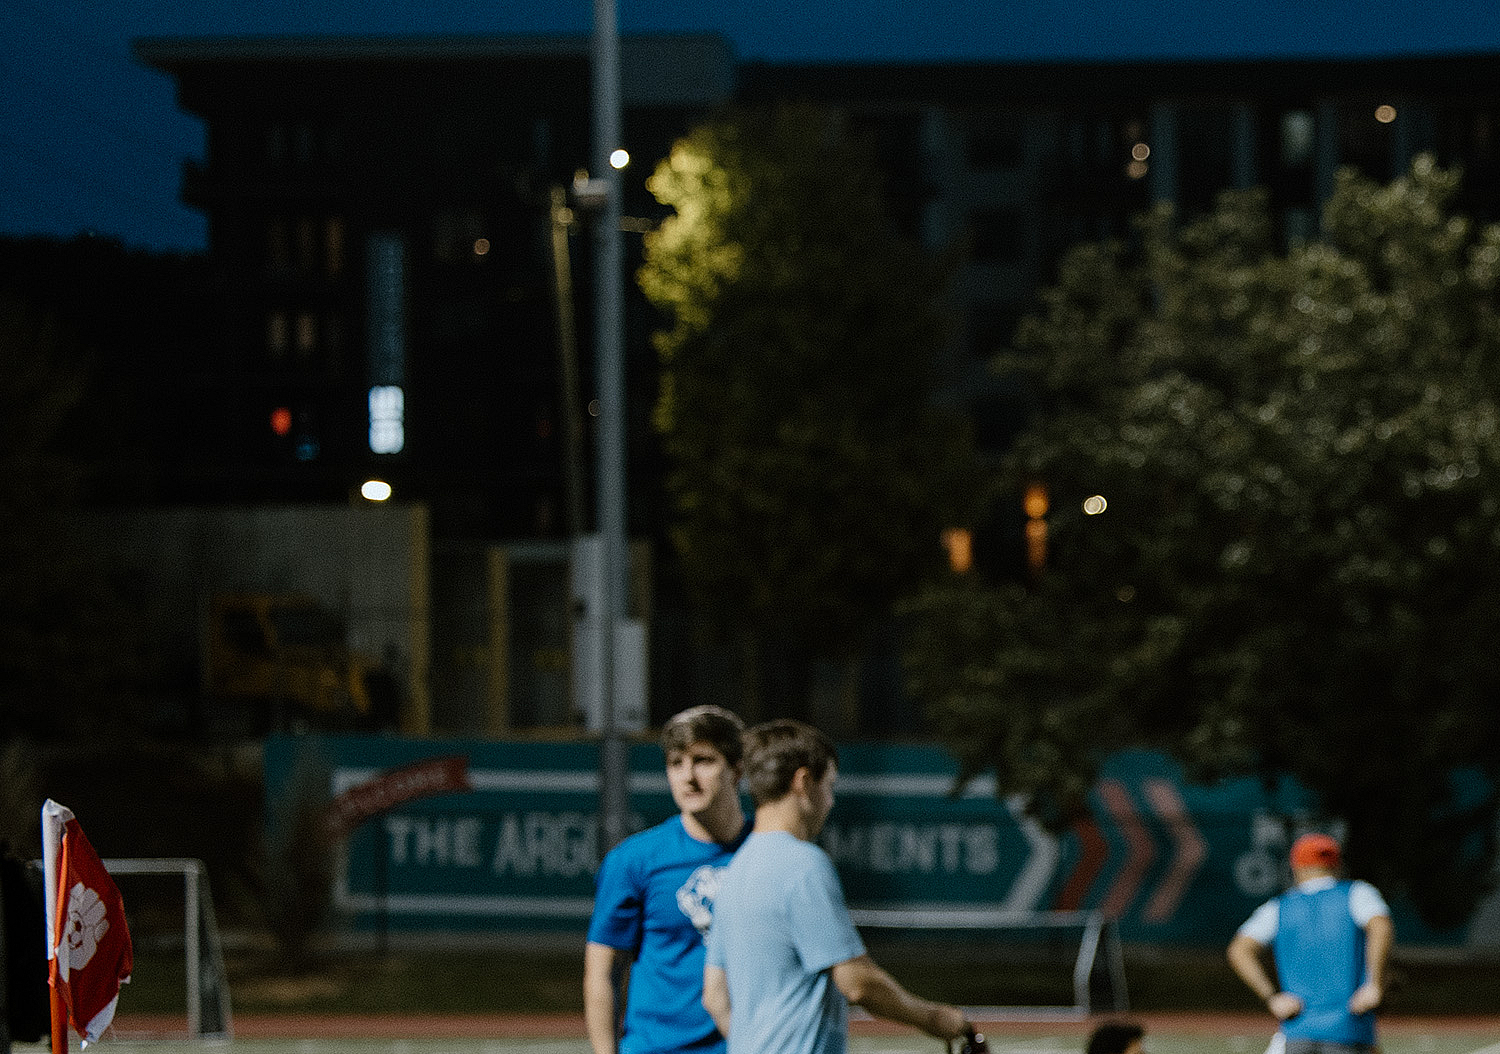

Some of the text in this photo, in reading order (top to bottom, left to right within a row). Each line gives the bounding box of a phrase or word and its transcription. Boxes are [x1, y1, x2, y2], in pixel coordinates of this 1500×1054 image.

[385, 811, 998, 877] THE ARG MENTS
